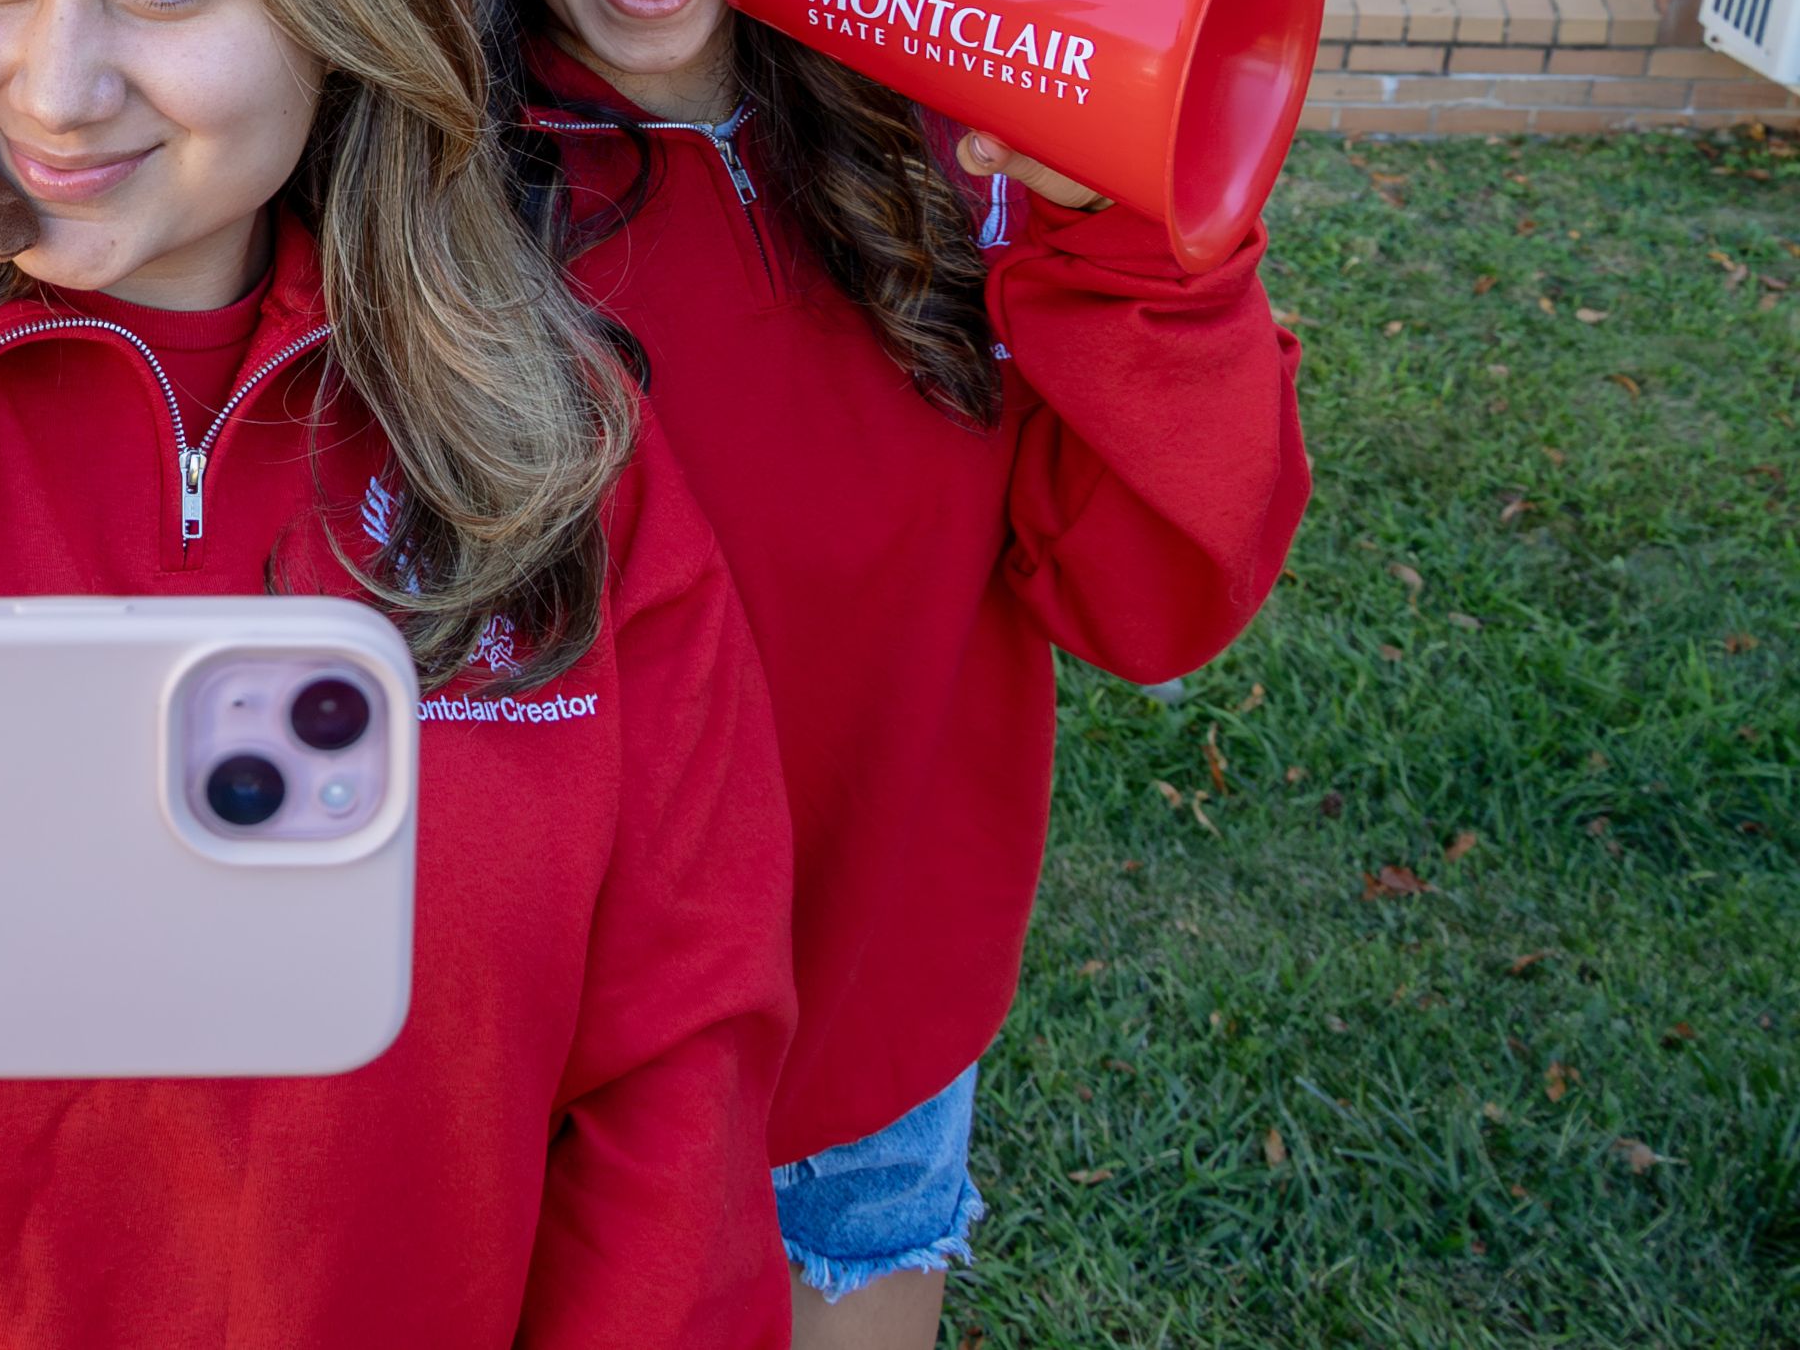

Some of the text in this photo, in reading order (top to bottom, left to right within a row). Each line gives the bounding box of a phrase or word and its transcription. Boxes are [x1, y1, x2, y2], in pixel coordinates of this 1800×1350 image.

[807, 7, 1090, 106] STATE UNIVERSITY
[416, 693, 599, 723] ontclairCreator
